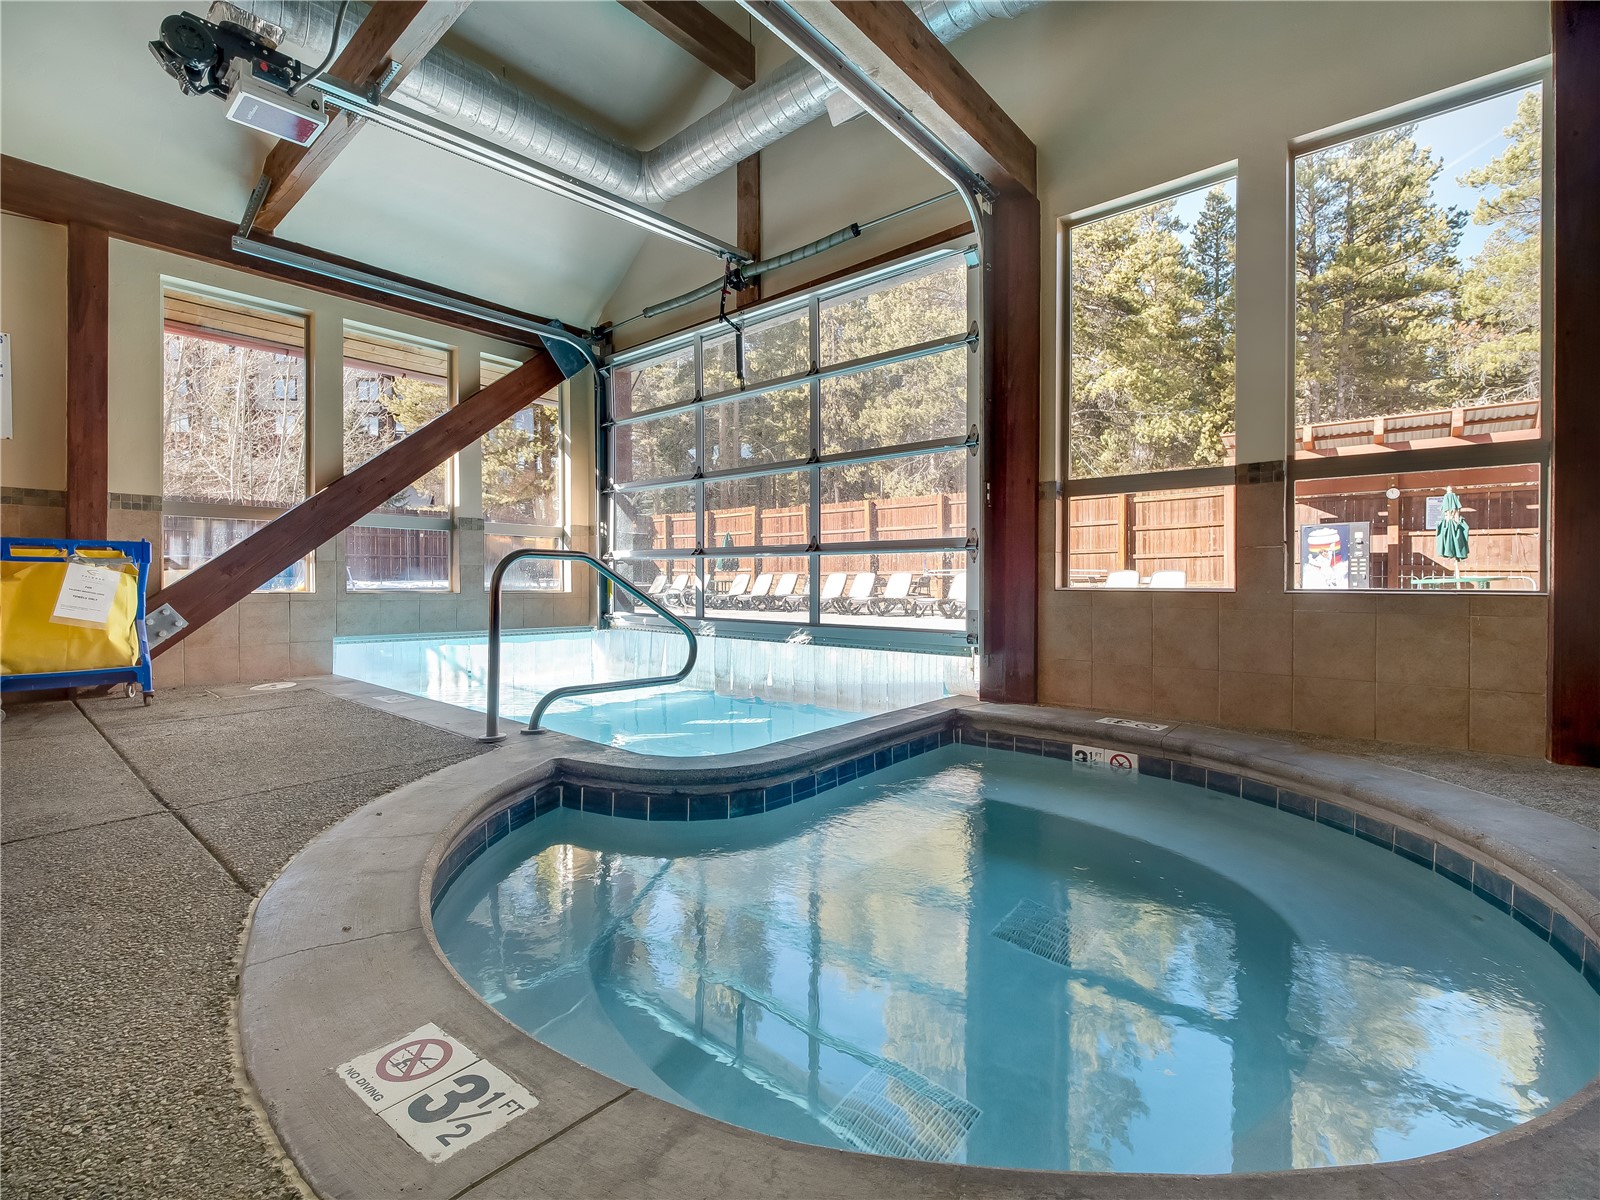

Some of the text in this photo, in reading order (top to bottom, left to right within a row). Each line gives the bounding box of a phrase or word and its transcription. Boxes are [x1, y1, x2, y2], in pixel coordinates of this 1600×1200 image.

[344, 1067, 385, 1103] NO DIVING
[407, 1074, 491, 1124] 3
[498, 1098, 526, 1116] FT
